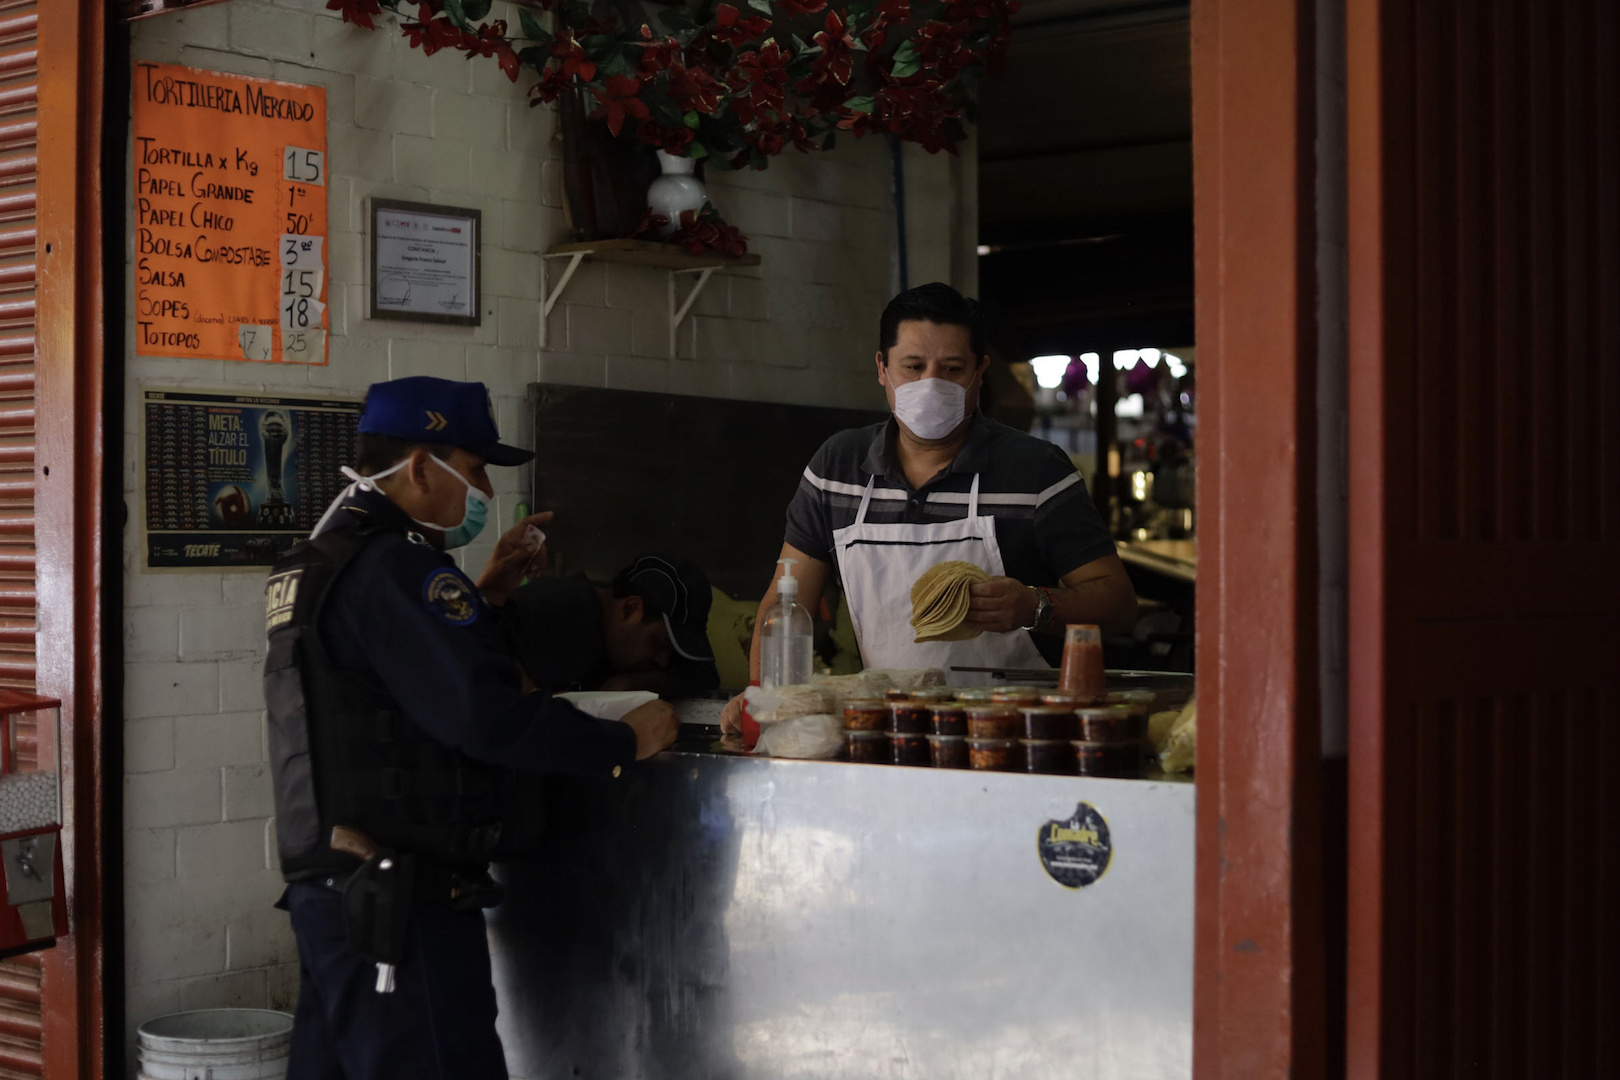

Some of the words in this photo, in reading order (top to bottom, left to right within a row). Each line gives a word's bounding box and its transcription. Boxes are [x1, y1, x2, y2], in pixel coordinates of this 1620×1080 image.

[136, 63, 242, 114] TORTILLERIA
[246, 83, 314, 121] MERCADO
[137, 137, 213, 168] TORTILLA
[236, 147, 258, 176] Kg
[287, 150, 319, 182] 15
[138, 168, 185, 197] PAPEL
[191, 171, 255, 204] GRANDE
[138, 198, 186, 228] PAPEL
[190, 202, 235, 232] CHICO
[139, 228, 192, 258] BOLSA
[138, 257, 186, 288] SALSA
[284, 271, 314, 298] 15
[138, 289, 190, 320] SOPES
[285, 298, 310, 328] 18
[137, 321, 201, 350] TOTOPOS
[241, 331, 257, 352] 17
[286, 333, 307, 353] 25
[208, 414, 244, 431] META:
[208, 432, 236, 447] ALZAR
[238, 433, 250, 447] EL
[208, 447, 247, 466] TÍTULO
[184, 543, 221, 558] TECATE
